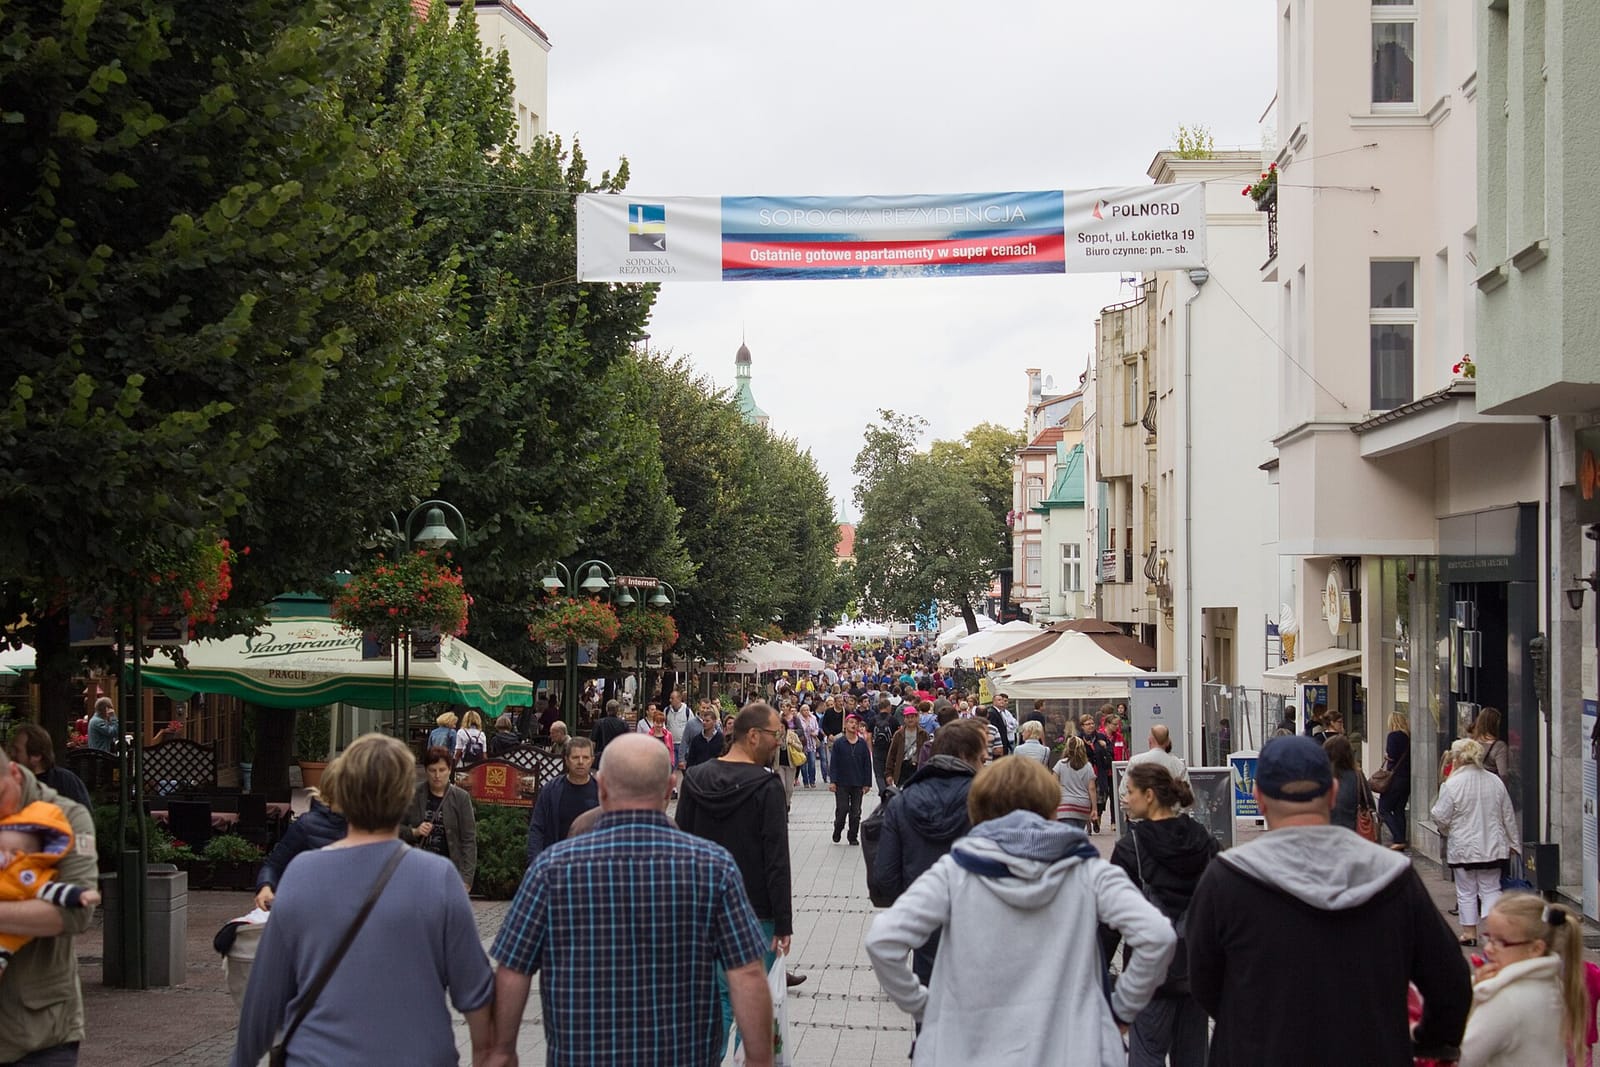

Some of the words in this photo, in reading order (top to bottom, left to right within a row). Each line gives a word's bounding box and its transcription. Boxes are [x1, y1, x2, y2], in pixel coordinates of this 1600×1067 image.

[760, 208, 873, 226] SOPOCKA
[882, 204, 1026, 225] REZYDENCJA
[1112, 203, 1180, 217] POLNORD
[1078, 232, 1112, 244] Sopot,
[1115, 231, 1129, 242] ul.
[1131, 230, 1178, 241] Łokietka
[1182, 229, 1195, 240] 19
[750, 249, 802, 261] Ostatnie
[805, 249, 852, 263] gotowe
[855, 247, 936, 262] apartamenty
[938, 248, 949, 258] w
[952, 246, 988, 260] super
[991, 242, 1036, 257] cenach
[1085, 247, 1110, 256] Biuro
[1112, 247, 1148, 257] czynne:
[1150, 247, 1164, 256] pn.
[1174, 245, 1188, 254] sb.
[625, 258, 670, 266] SOPOCKA
[628, 578, 656, 587] Internet
[239, 632, 362, 655] Staropramen
[268, 669, 307, 680] PRAGUE
